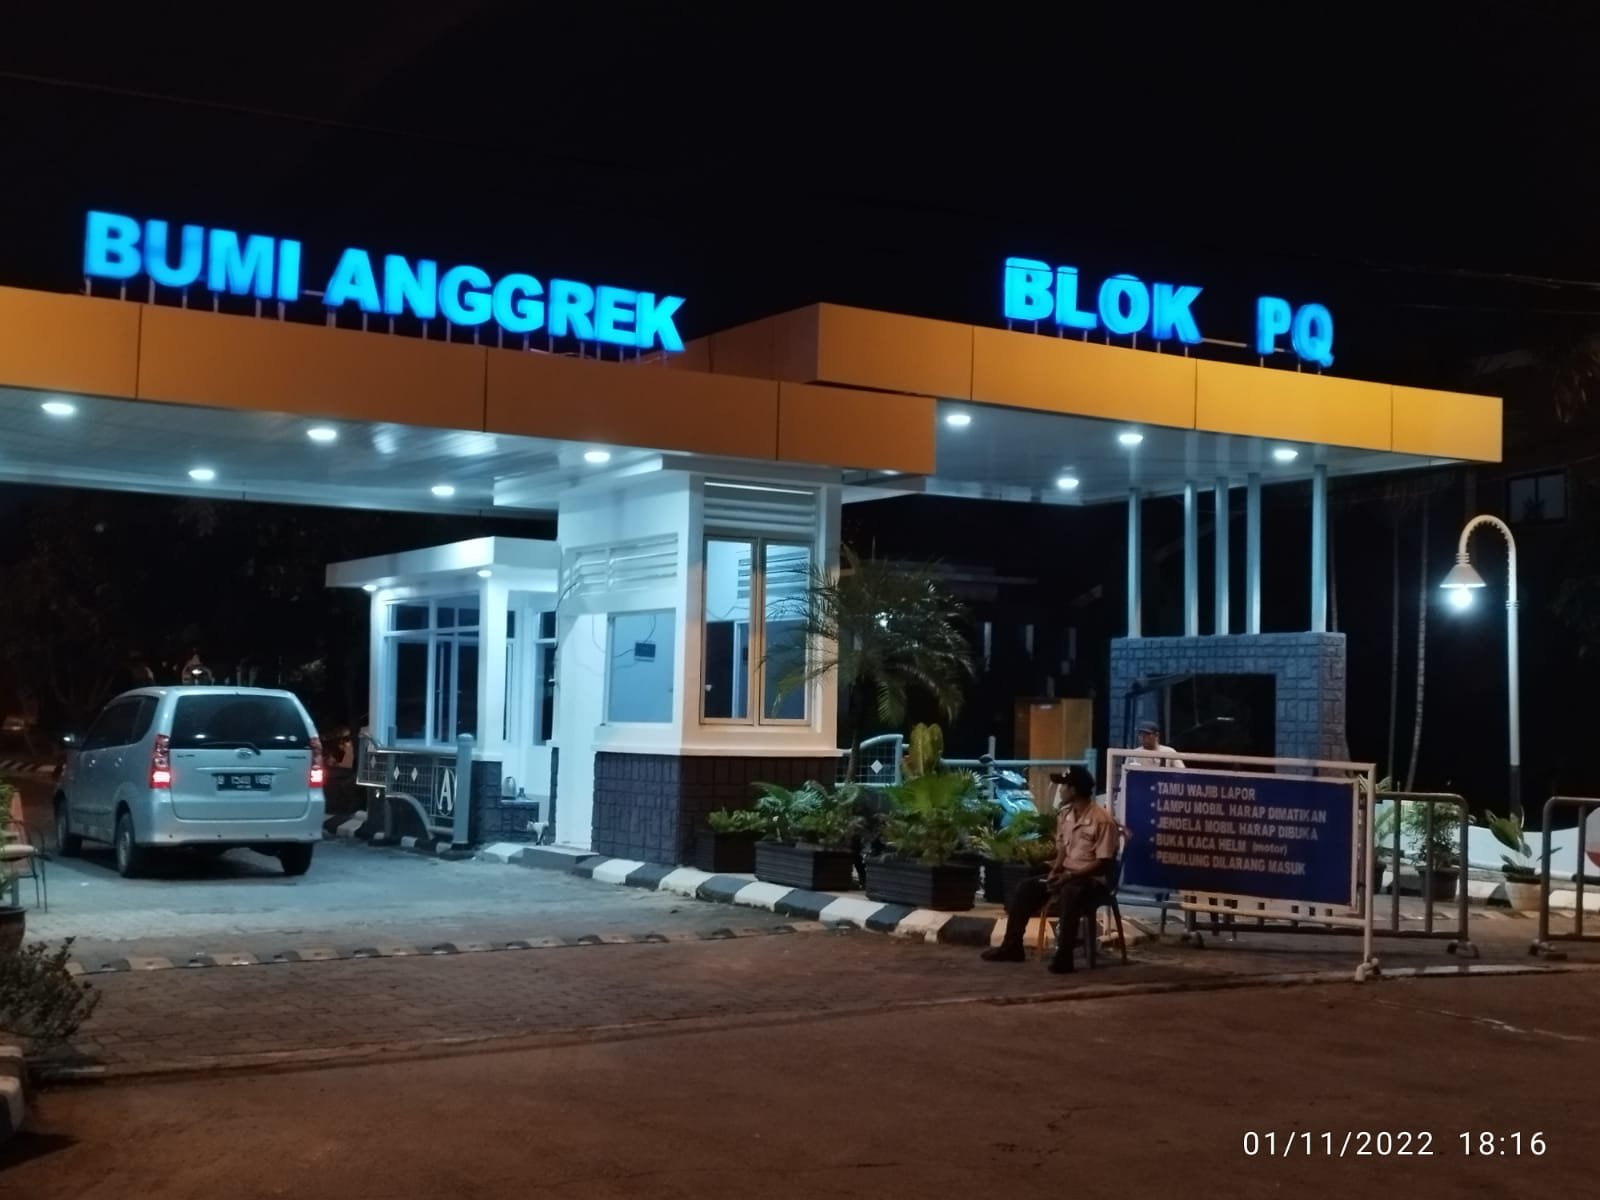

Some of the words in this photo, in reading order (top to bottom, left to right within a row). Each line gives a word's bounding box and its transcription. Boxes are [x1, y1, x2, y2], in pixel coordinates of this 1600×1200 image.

[84, 210, 302, 300] BUMI
[322, 248, 685, 352] ANGGREK
[1003, 256, 1203, 344] BLOK
[1256, 296, 1335, 367] PQ
[1157, 782, 1185, 796] TAMU
[1187, 784, 1218, 798] WAJIB
[1221, 787, 1256, 801] LAPOR
[1156, 799, 1192, 814] LAMPU
[1193, 802, 1225, 816] MOBIL
[1229, 804, 1266, 819] HARAP
[1268, 807, 1327, 823] DIMATIKAN
[1157, 816, 1202, 832] JENDELA
[1204, 820, 1236, 834] MOBIL
[1239, 822, 1276, 837] HARAP
[1278, 825, 1319, 841] DIBUKA
[1156, 834, 1185, 848] BUKA
[1187, 836, 1215, 850] KACA
[1218, 838, 1247, 853] HELM
[1156, 851, 1210, 868] PEMULUNG
[1212, 855, 1266, 872] DILARANG
[1268, 860, 1306, 876] MASUK
